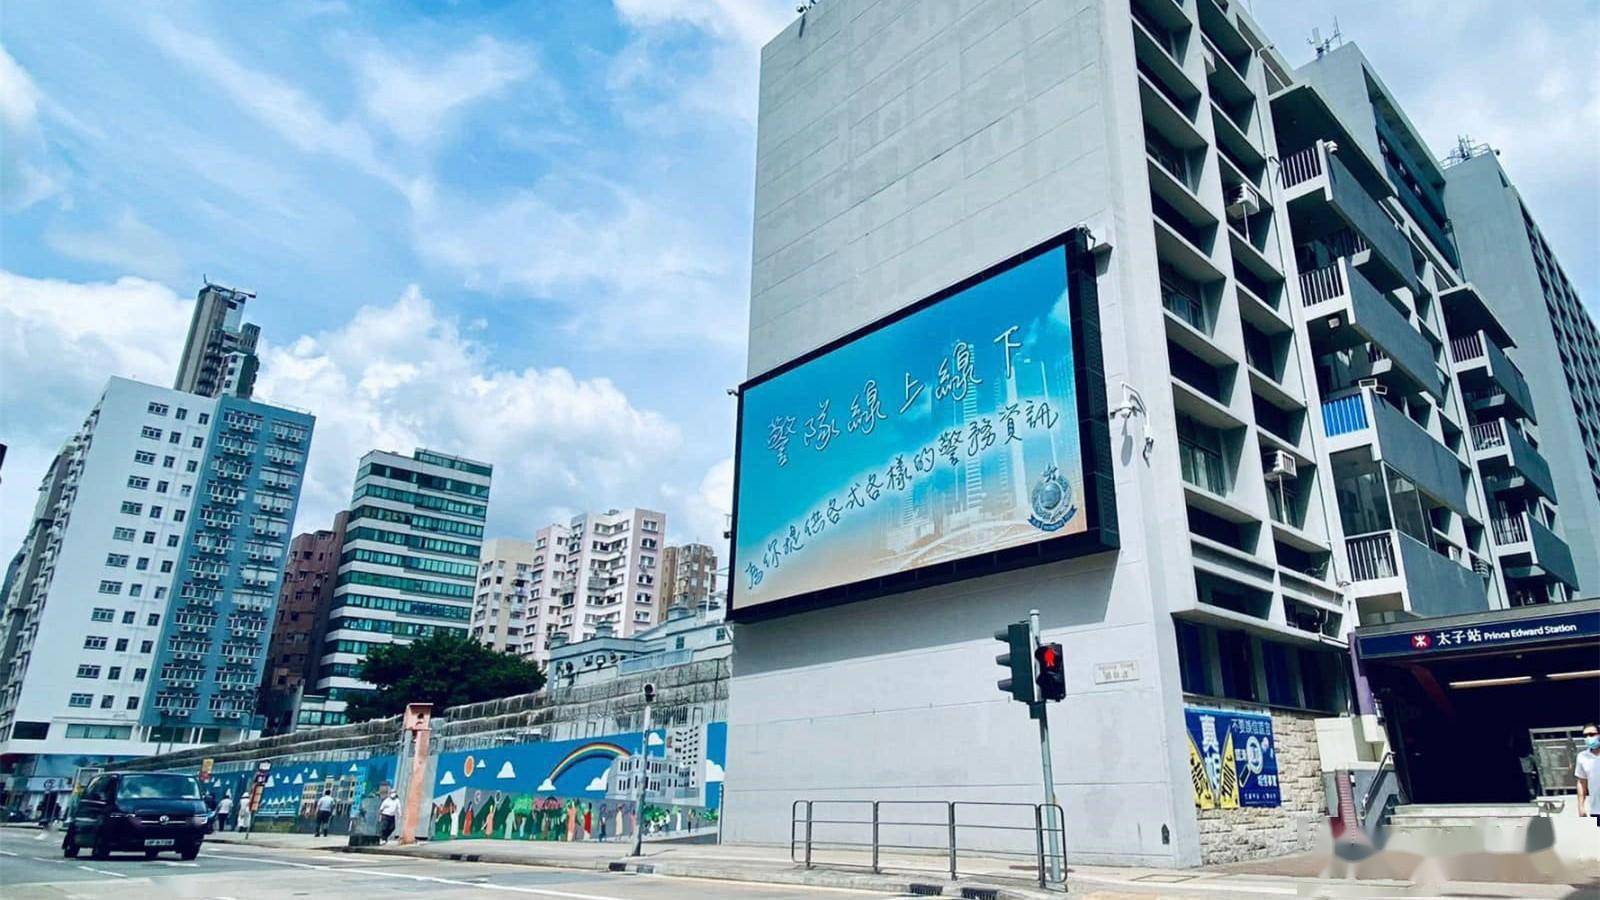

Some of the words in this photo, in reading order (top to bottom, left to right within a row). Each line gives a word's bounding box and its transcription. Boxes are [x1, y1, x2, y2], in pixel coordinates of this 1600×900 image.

[768, 325, 1021, 465] 警隊線上線下
[1436, 629, 1482, 646] 太子站
[1484, 631, 1510, 641] Prince
[1511, 627, 1544, 638] Edward
[1544, 624, 1577, 635] Station
